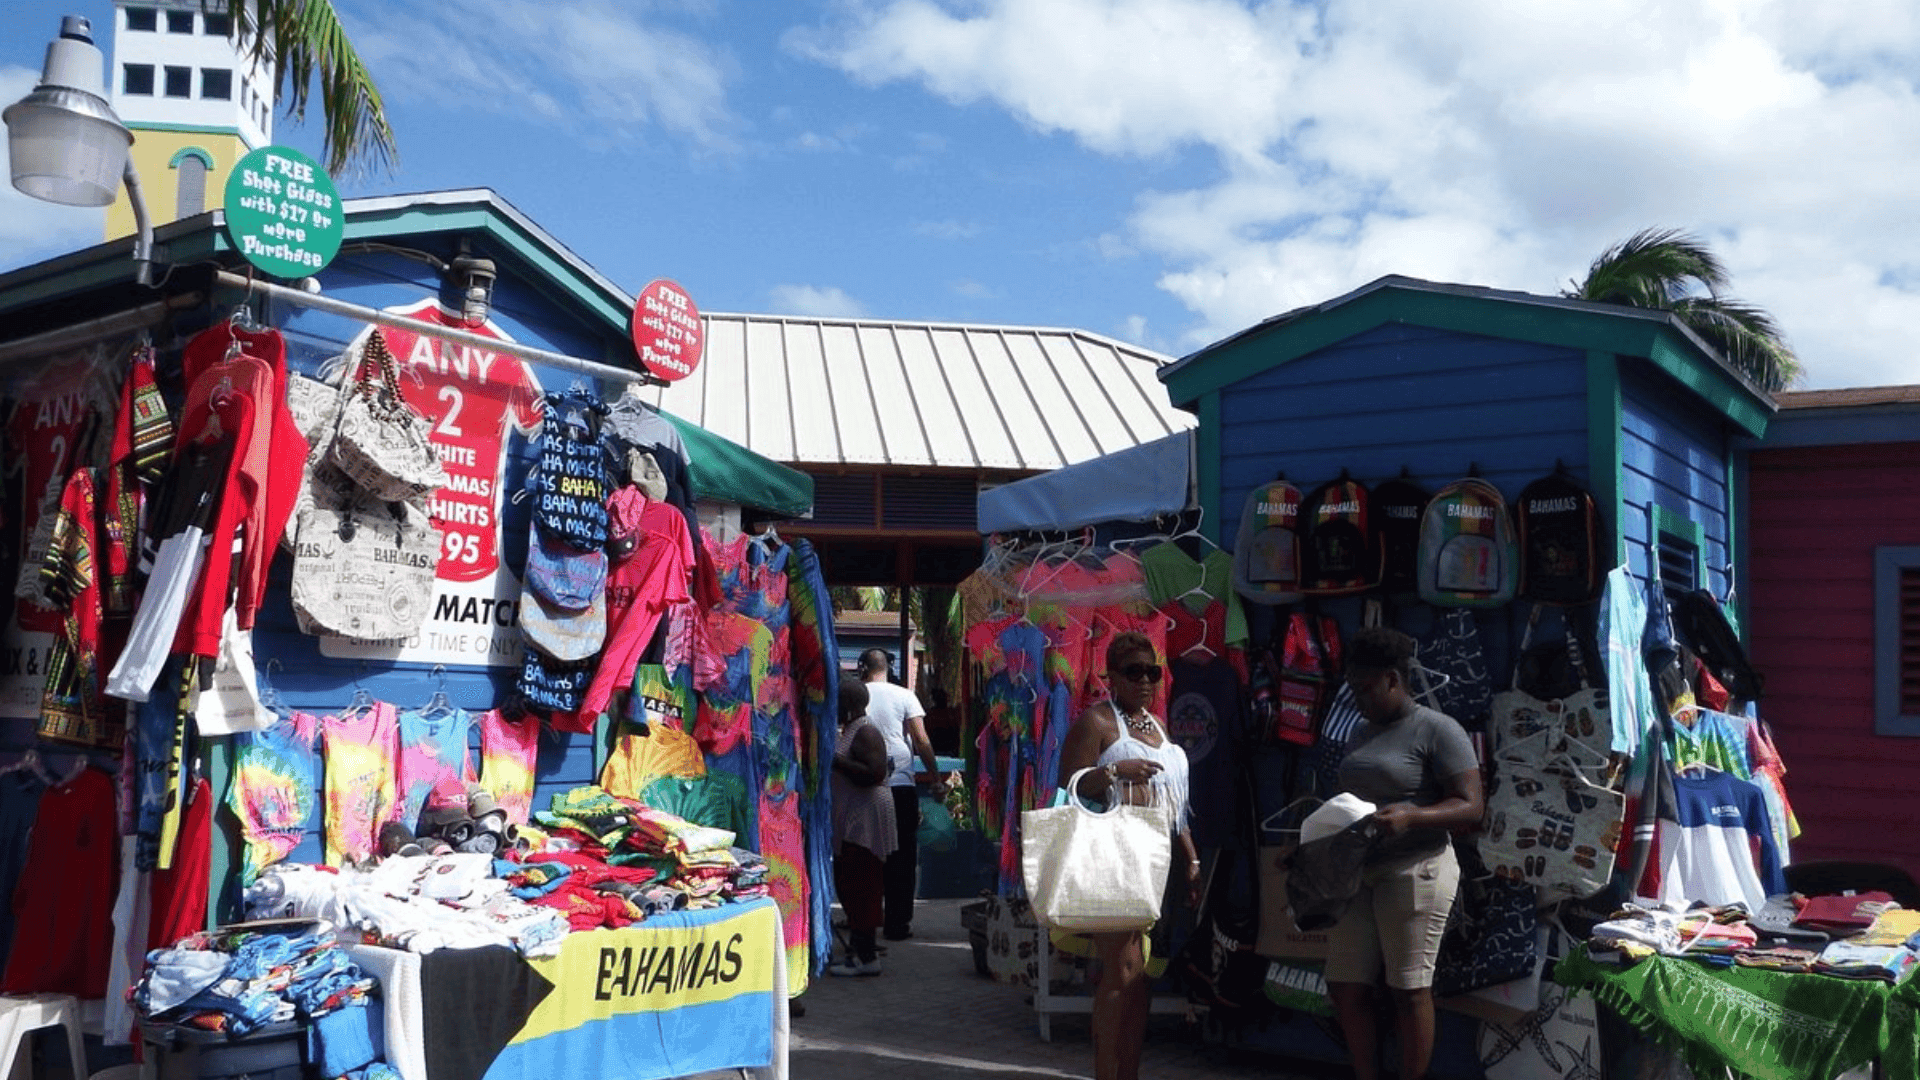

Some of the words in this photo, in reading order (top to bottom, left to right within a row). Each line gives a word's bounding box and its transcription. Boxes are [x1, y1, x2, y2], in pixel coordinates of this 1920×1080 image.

[265, 154, 314, 183] FREE
[243, 169, 281, 195] Shot
[286, 182, 331, 209] Glass
[240, 196, 276, 214] with
[280, 201, 307, 223] $17
[313, 210, 331, 229] or
[243, 235, 322, 267] Purchase
[645, 296, 668, 317] Shot
[659, 286, 688, 310] FREE
[409, 335, 496, 384] ANY
[642, 345, 690, 375] Purchase
[34, 391, 86, 430] ANY
[437, 386, 463, 436] 2
[51, 435, 66, 476] 2
[561, 476, 596, 497] BAHA
[542, 494, 578, 515] BAHA
[1256, 502, 1298, 516] BAHAMAS
[1318, 500, 1361, 514] BAHAMAS
[1447, 504, 1494, 519] BAHAMAS
[1529, 497, 1577, 514] BAHAMAS
[445, 532, 480, 565] 95
[429, 633, 467, 652] TIME
[475, 635, 517, 655] ONLY
[594, 932, 743, 1001] BAHAMAS
